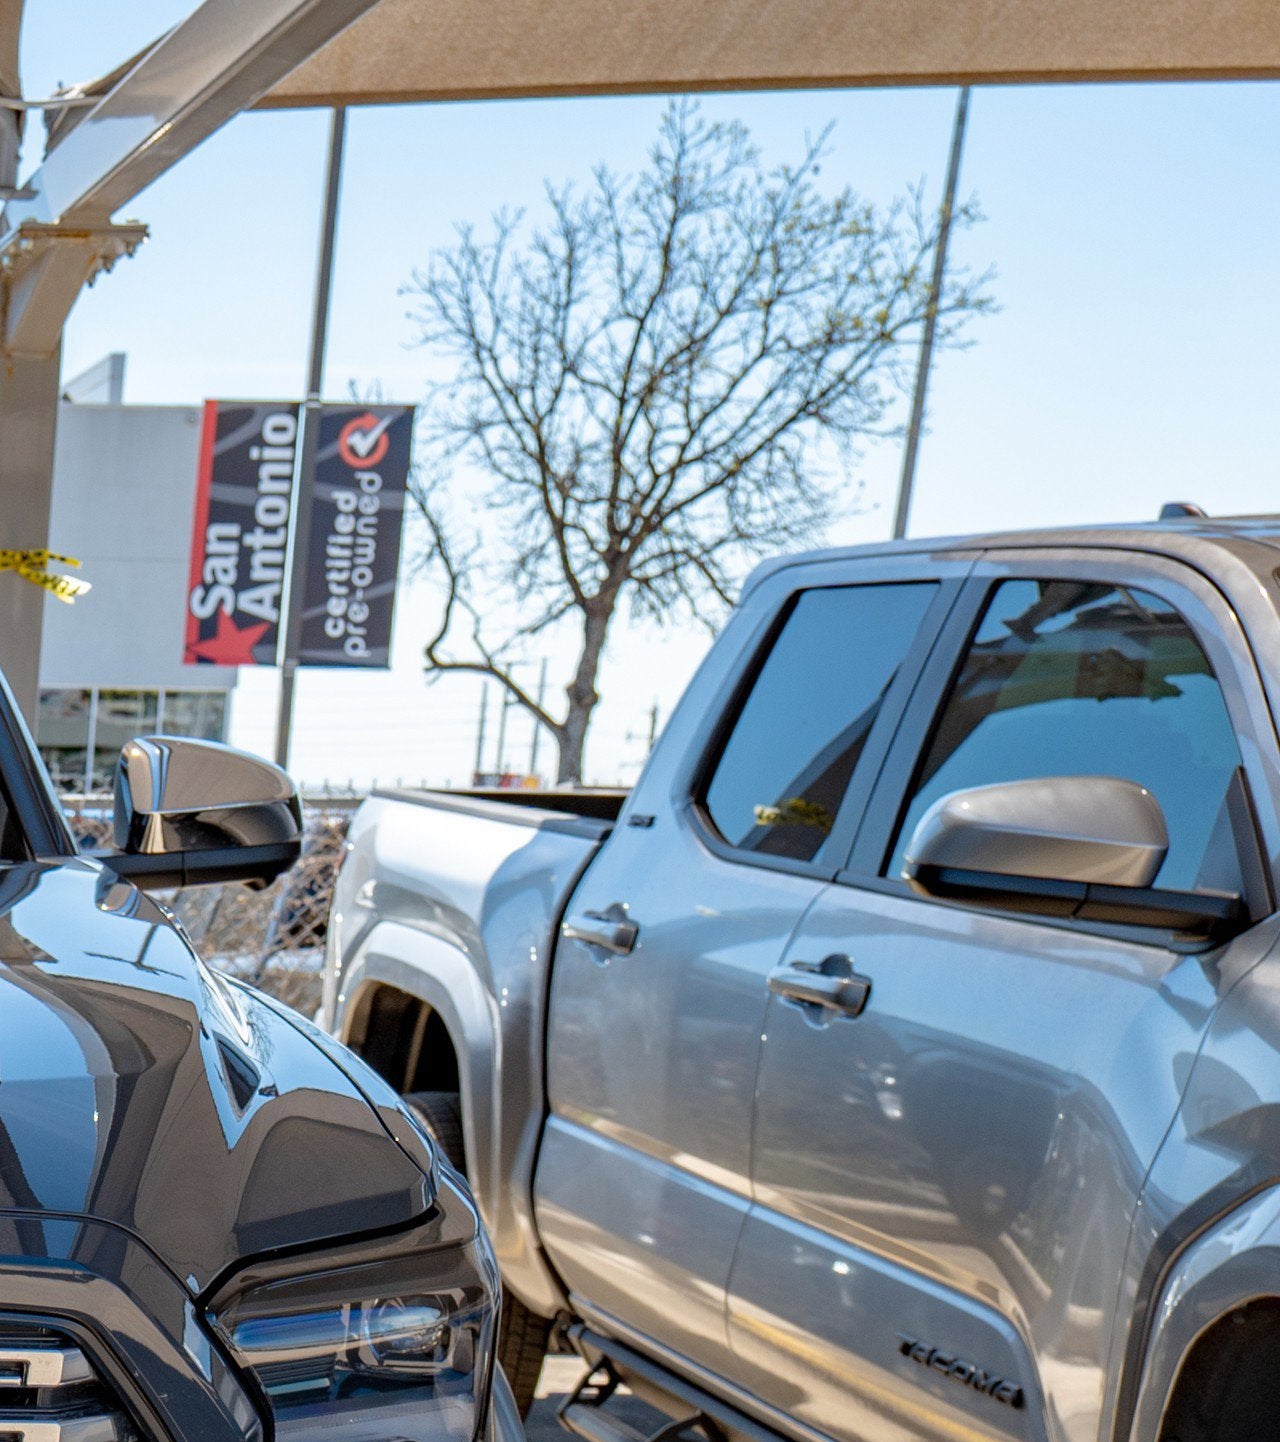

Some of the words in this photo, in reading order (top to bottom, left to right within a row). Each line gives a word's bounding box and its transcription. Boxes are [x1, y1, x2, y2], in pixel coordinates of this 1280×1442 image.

[190, 521, 241, 619] San
[237, 413, 298, 623] Antonio
[324, 490, 359, 638] certified
[343, 471, 383, 658] pre-owned
